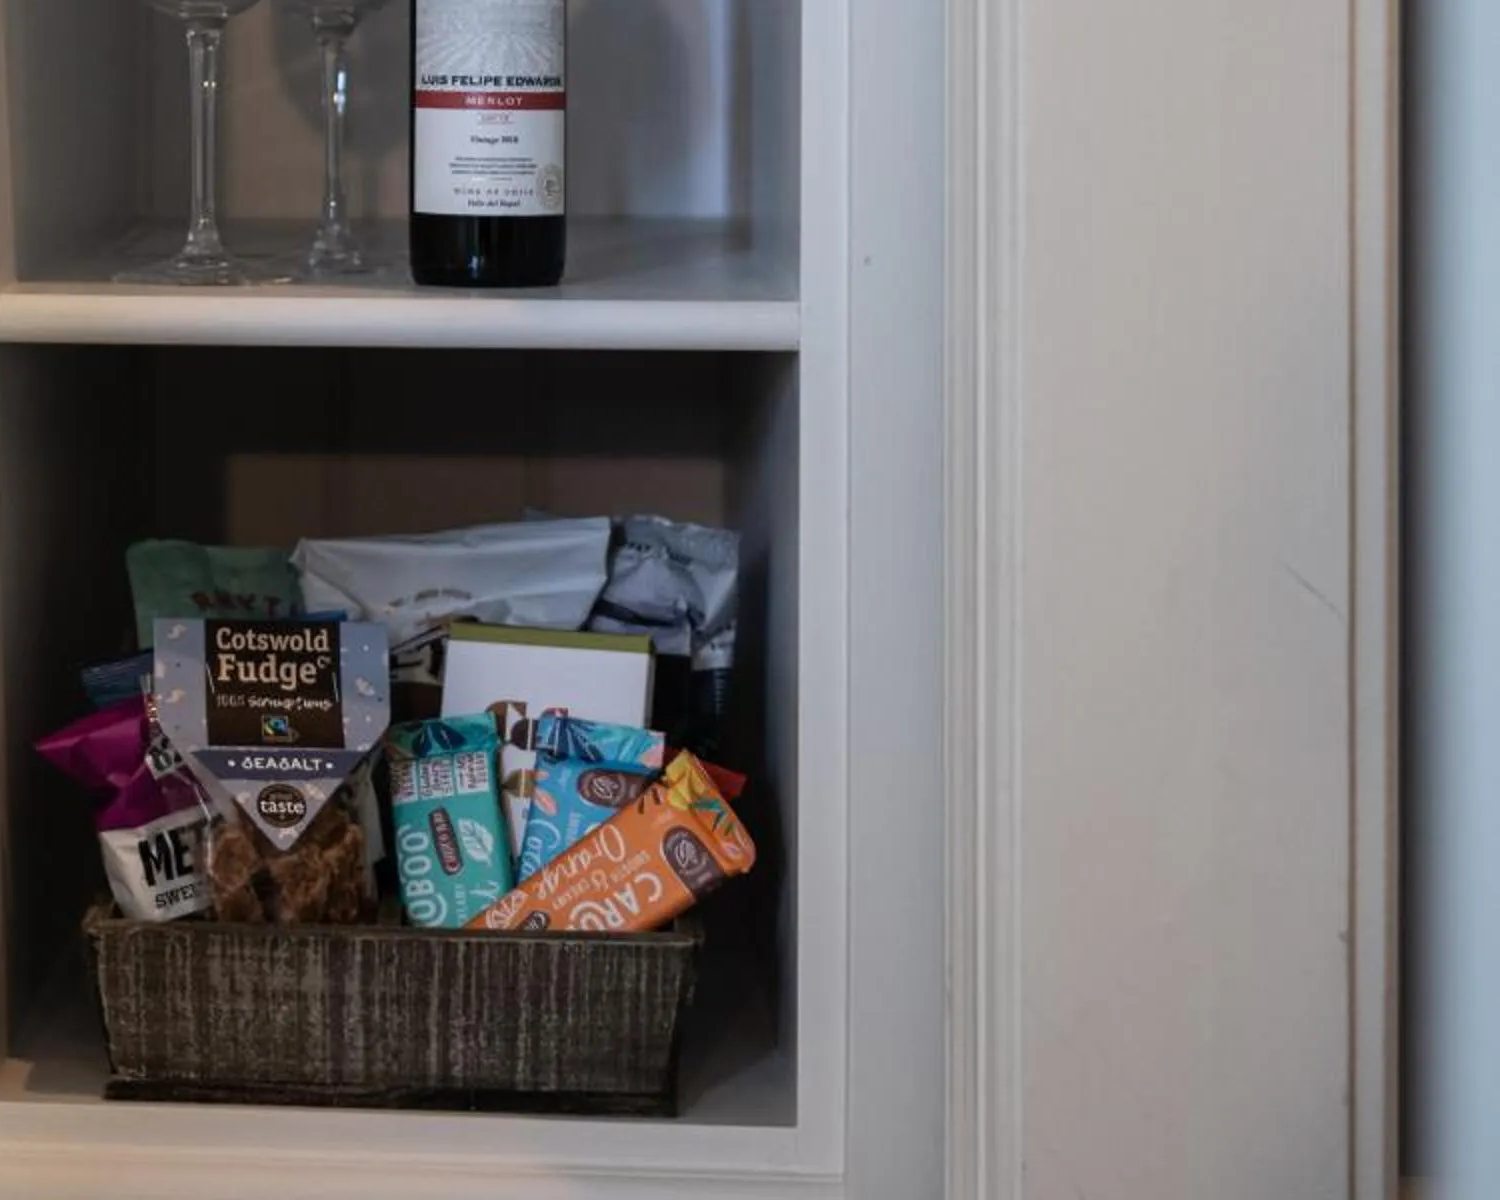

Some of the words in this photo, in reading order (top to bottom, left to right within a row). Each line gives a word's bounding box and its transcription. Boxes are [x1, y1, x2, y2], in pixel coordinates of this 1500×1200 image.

[421, 75, 448, 85] LUIS
[452, 75, 502, 86] FELIPE
[466, 96, 523, 106] MERLOT
[216, 626, 329, 651] Cotswold
[217, 654, 317, 690] Fudge
[241, 757, 323, 771] SEASALT
[260, 799, 305, 815] taste
[535, 823, 626, 901] Orange
